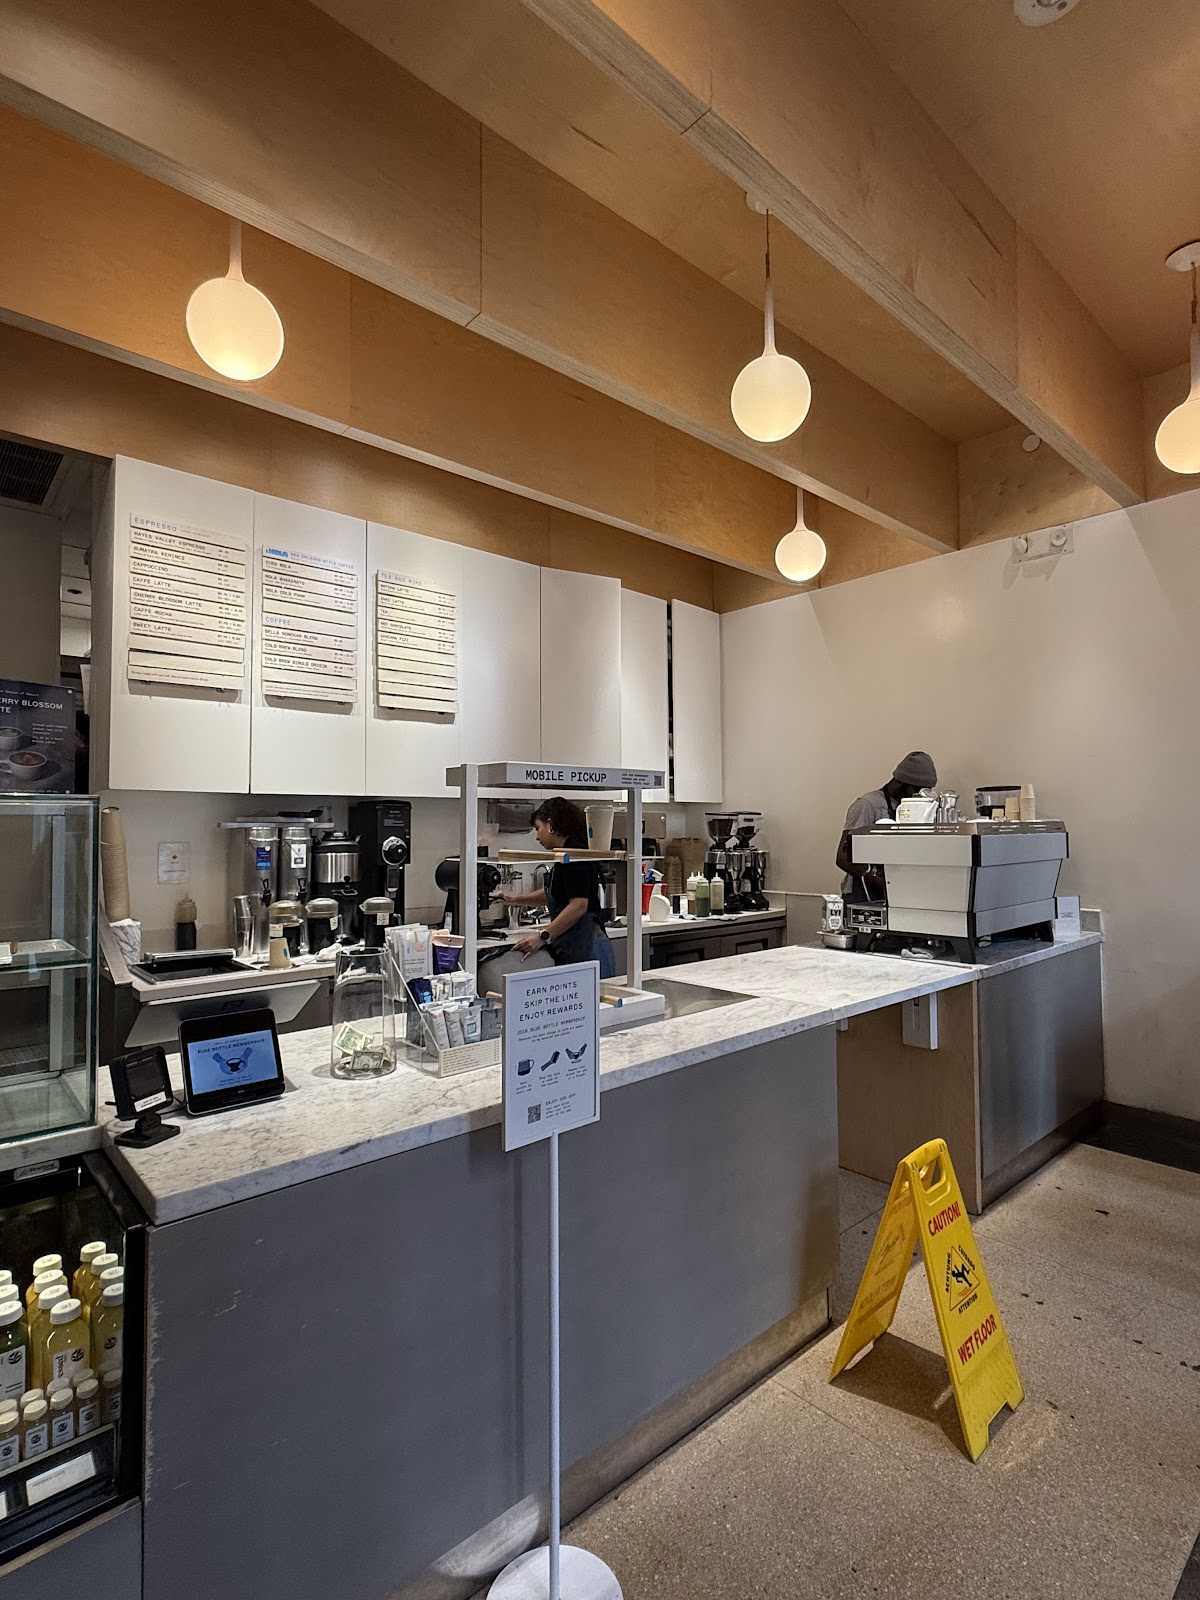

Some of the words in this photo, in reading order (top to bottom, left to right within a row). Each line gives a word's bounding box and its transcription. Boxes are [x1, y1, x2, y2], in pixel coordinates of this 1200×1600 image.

[135, 518, 176, 532] ESPRESSO
[134, 546, 158, 555] SUMATRA
[179, 541, 205, 550] ESPRESSO
[133, 562, 168, 572] CAPPUCCINO
[134, 592, 155, 600] CHERRY
[159, 596, 182, 604] BLOSSOM
[266, 617, 291, 625] COFFEE
[22, 700, 62, 710] BLOSSOM
[526, 770, 563, 781] MOBILE
[571, 772, 606, 783] PICKUP
[527, 987, 547, 996] EARN
[550, 982, 577, 992] POINTS
[525, 999, 542, 1008] SKIP
[545, 996, 559, 1004] THE
[563, 992, 578, 1001] LINE
[520, 1010, 544, 1021] ENJOY
[547, 1003, 583, 1015] REWARDS
[561, 1016, 586, 1025] MEMBERSHIP
[233, 1039, 264, 1047] MEMBERSHIP
[928, 1201, 962, 1236] CAUTION!
[958, 1245, 975, 1271] CUIDADO
[958, 1293, 978, 1315] ATTENTION
[958, 1338, 973, 1365] WET
[972, 1314, 997, 1350] FLOOR
